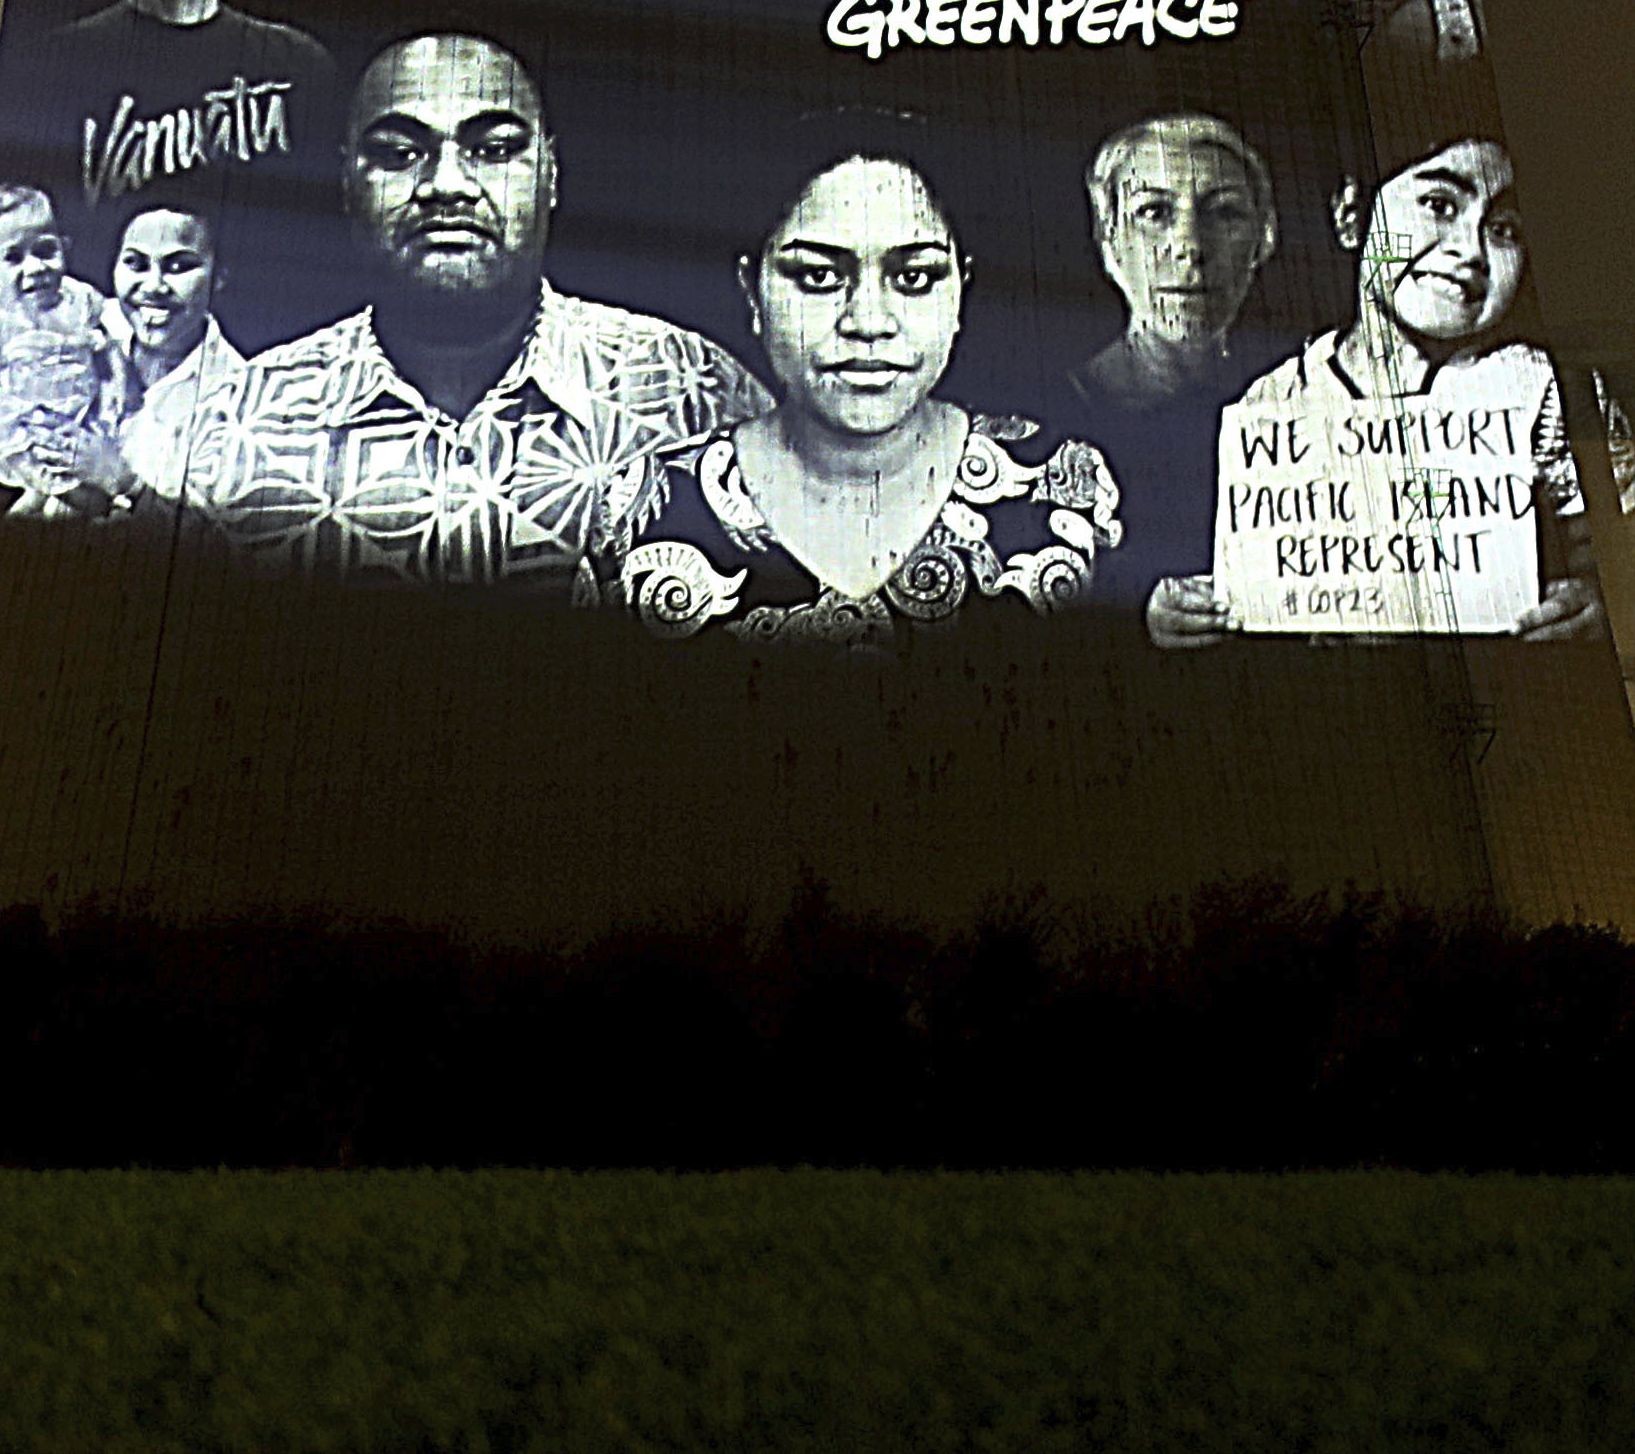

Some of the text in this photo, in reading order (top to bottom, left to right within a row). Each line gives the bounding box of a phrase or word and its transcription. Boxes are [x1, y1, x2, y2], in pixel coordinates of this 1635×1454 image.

[82, 75, 293, 207] Vanuatu
[1240, 407, 1527, 469] WE SUPPORT
[1229, 473, 1535, 532] PACIFIC ISLAND
[1276, 530, 1491, 578] REPRESENT
